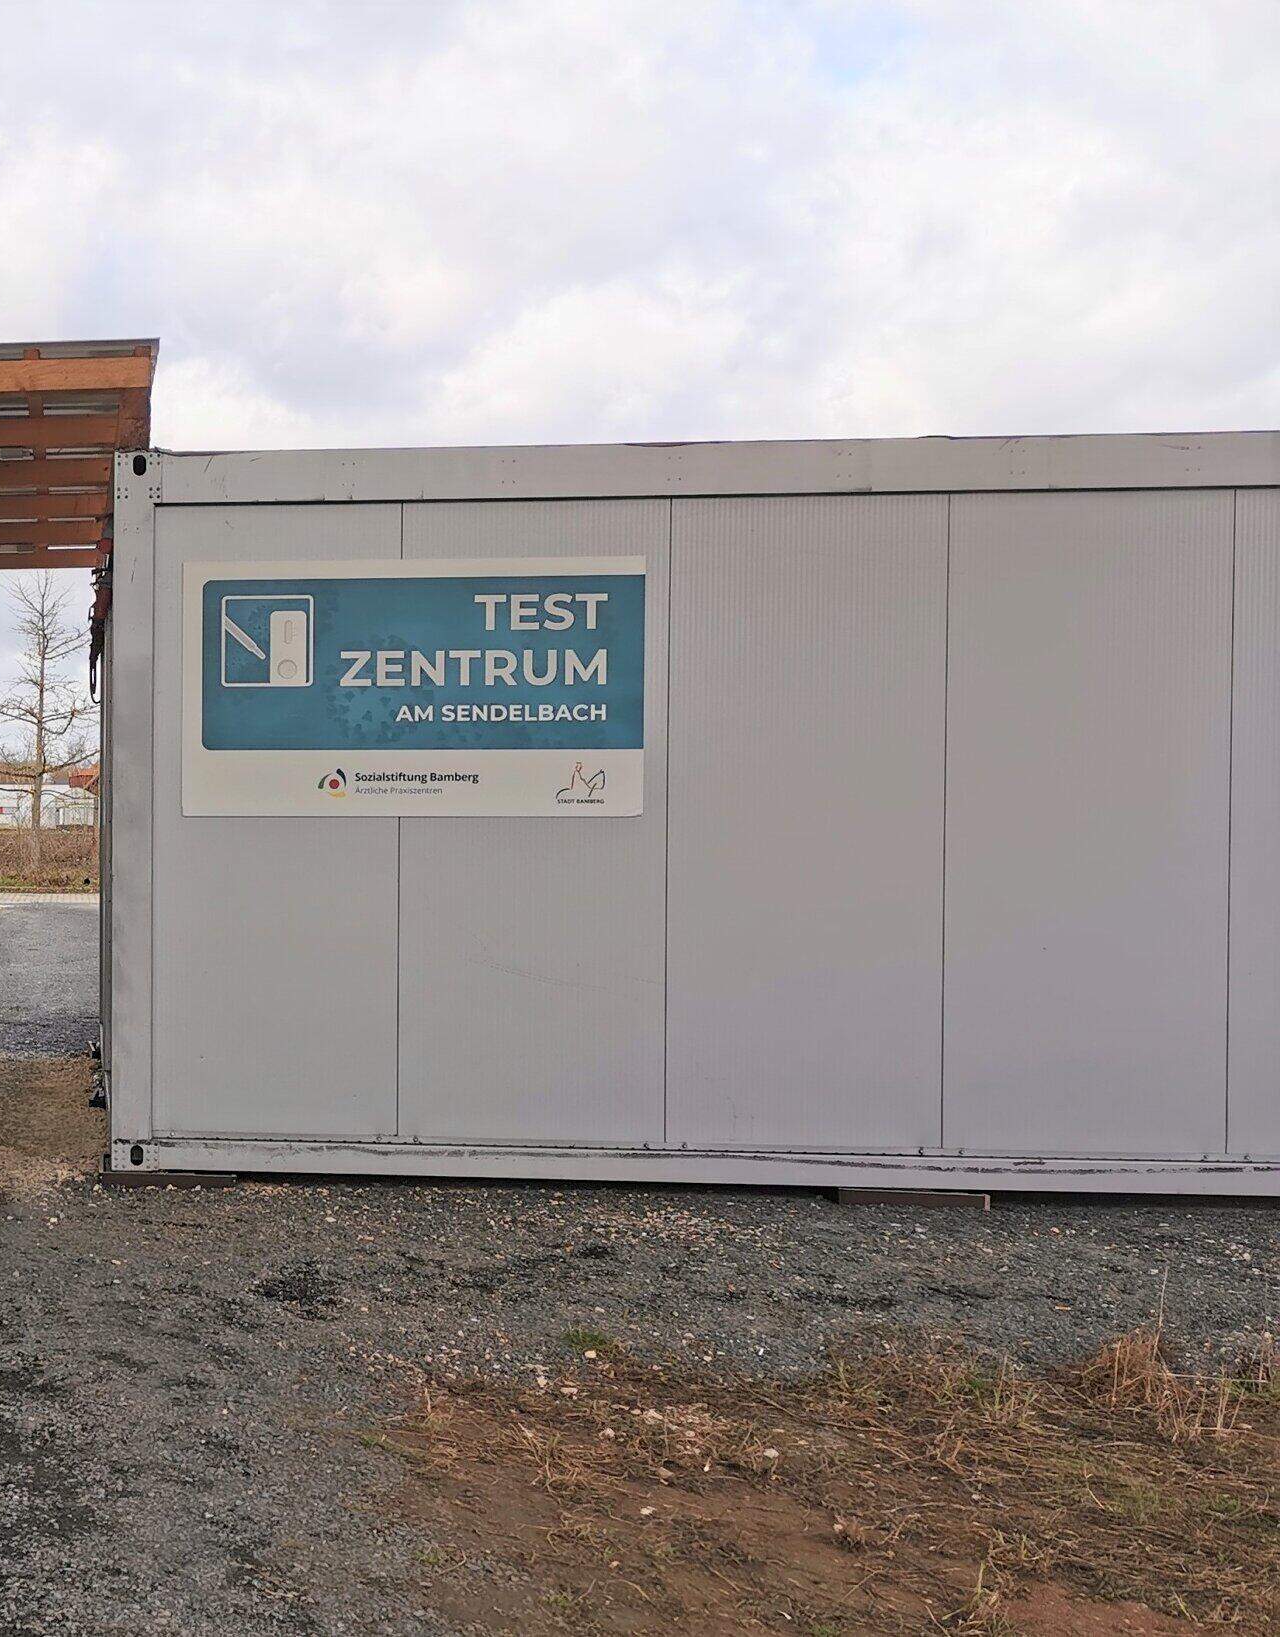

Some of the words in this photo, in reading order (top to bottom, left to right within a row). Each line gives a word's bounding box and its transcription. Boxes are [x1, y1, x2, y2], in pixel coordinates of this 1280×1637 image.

[474, 593, 609, 631] TEST
[339, 649, 608, 687] ZENTRUM
[395, 705, 434, 722] AM
[441, 704, 608, 722] SENDELBACH
[355, 772, 428, 784] Sozialstiftung
[430, 772, 479, 784] Bamberg
[390, 786, 443, 795] Praxiszentren
